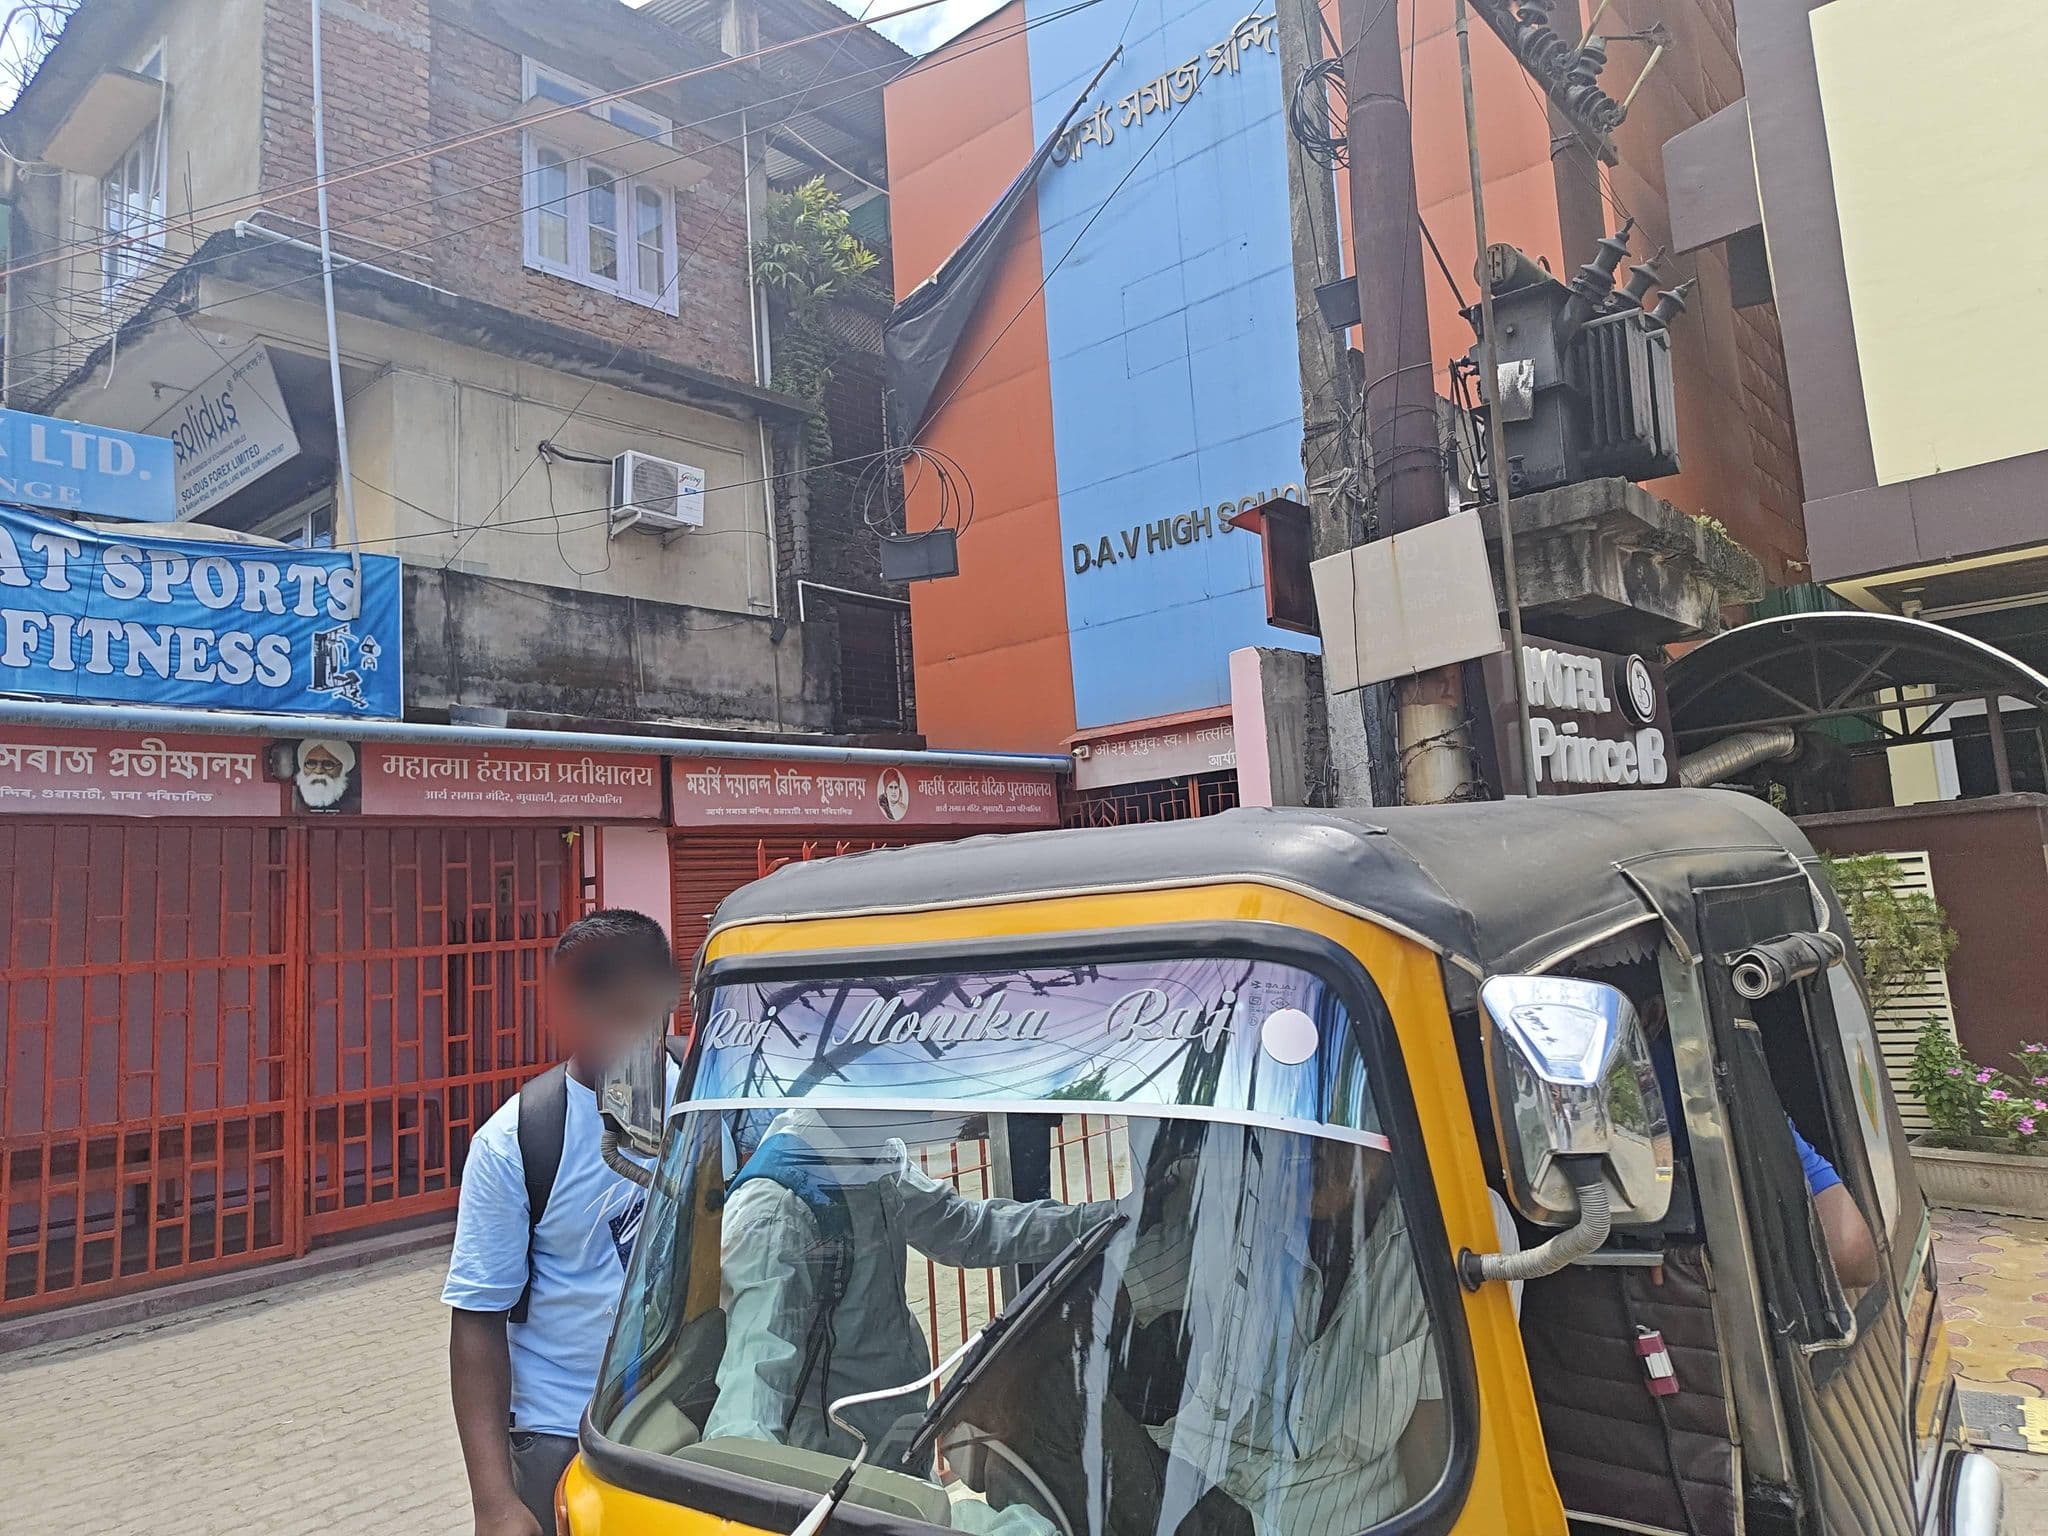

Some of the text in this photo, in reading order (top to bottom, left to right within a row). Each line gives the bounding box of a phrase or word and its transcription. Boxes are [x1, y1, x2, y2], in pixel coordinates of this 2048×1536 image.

[31, 423, 151, 480] LTD.
[181, 476, 210, 502] SOLIDUS
[208, 462, 231, 485] FOREX
[231, 443, 260, 470] LIMITED
[1146, 506, 1212, 554] HIGH
[101, 543, 361, 622] SPORTS
[0, 608, 294, 688] FITNESS
[1522, 645, 1612, 714] HOTEL
[380, 751, 654, 787] महात्मा हंसराज प्रतीक्षालय
[424, 788, 448, 801] आर्य
[918, 774, 946, 797] महर्षि
[947, 776, 979, 797] दयानंद
[1007, 781, 1052, 802] पुस्तकालय
[701, 988, 1236, 1055] Raj Monika Raj
